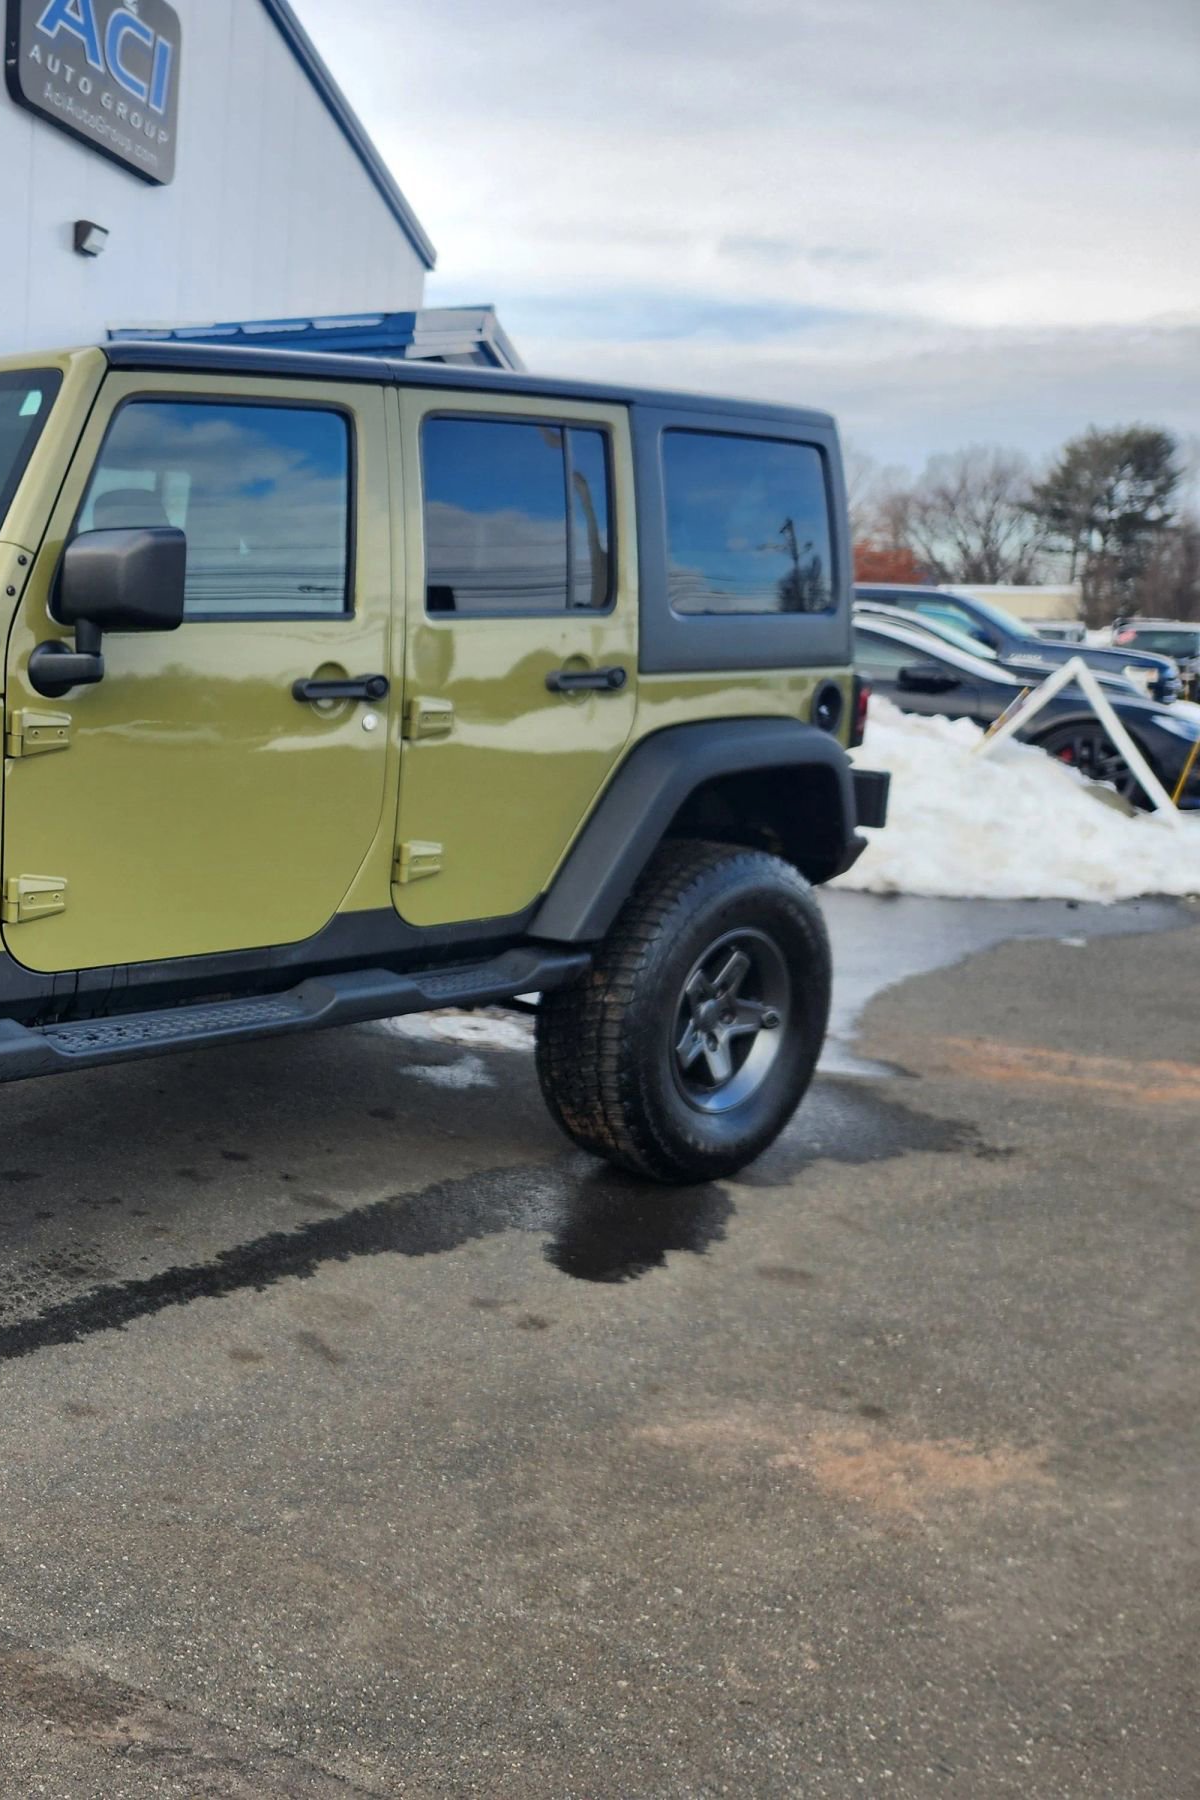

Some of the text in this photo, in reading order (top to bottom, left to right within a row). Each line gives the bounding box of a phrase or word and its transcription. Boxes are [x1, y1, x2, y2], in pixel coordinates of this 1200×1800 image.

[28, 44, 169, 145] AUTO GROUP
[36, 0, 173, 115] ACI
